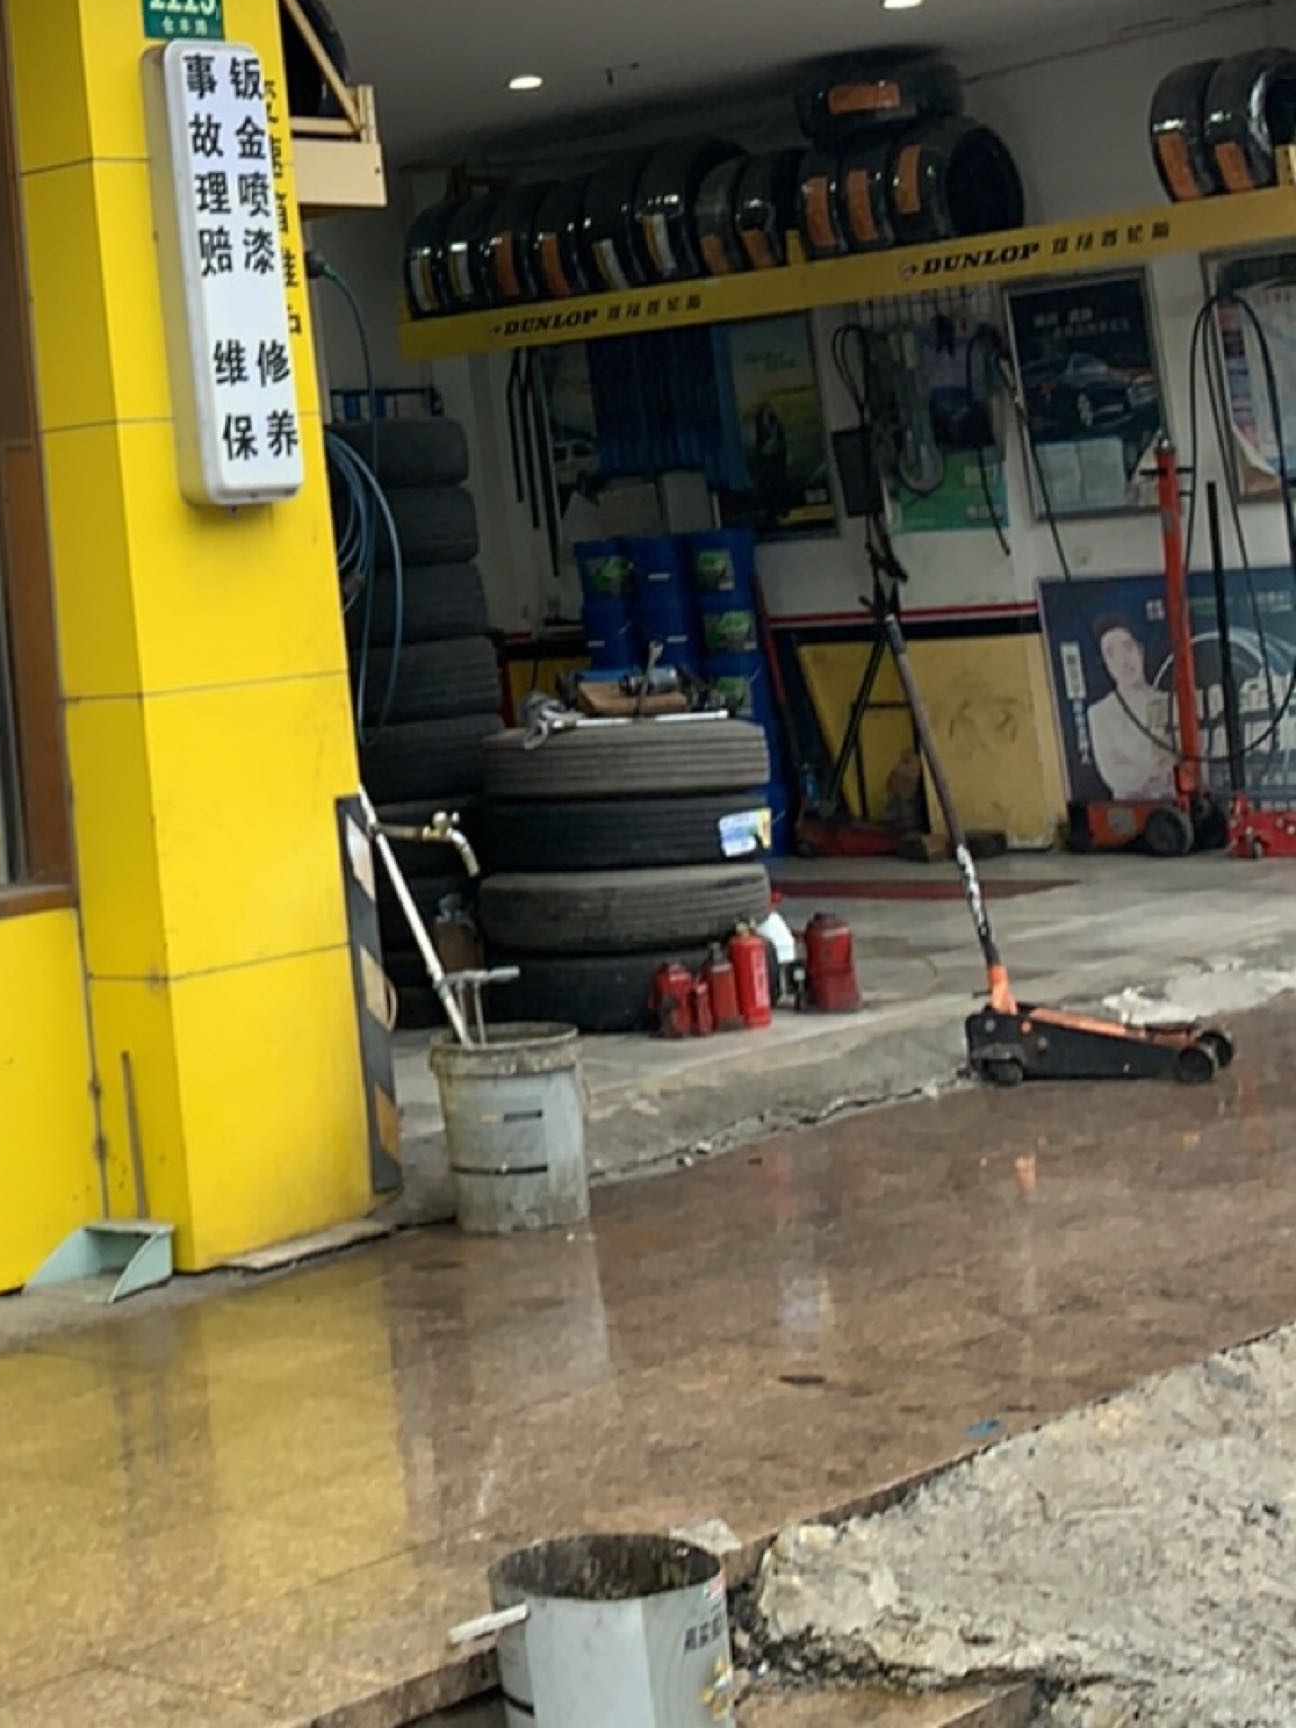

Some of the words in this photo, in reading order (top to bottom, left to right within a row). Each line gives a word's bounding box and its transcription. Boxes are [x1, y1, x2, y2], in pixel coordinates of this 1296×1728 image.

[181, 52, 234, 278] 事故理赔
[229, 55, 276, 276] 钣金喷漆
[920, 241, 1040, 276] DUNLOP
[503, 307, 599, 336] DUNLOP
[213, 338, 291, 388] 维修
[222, 409, 299, 462] 保养
